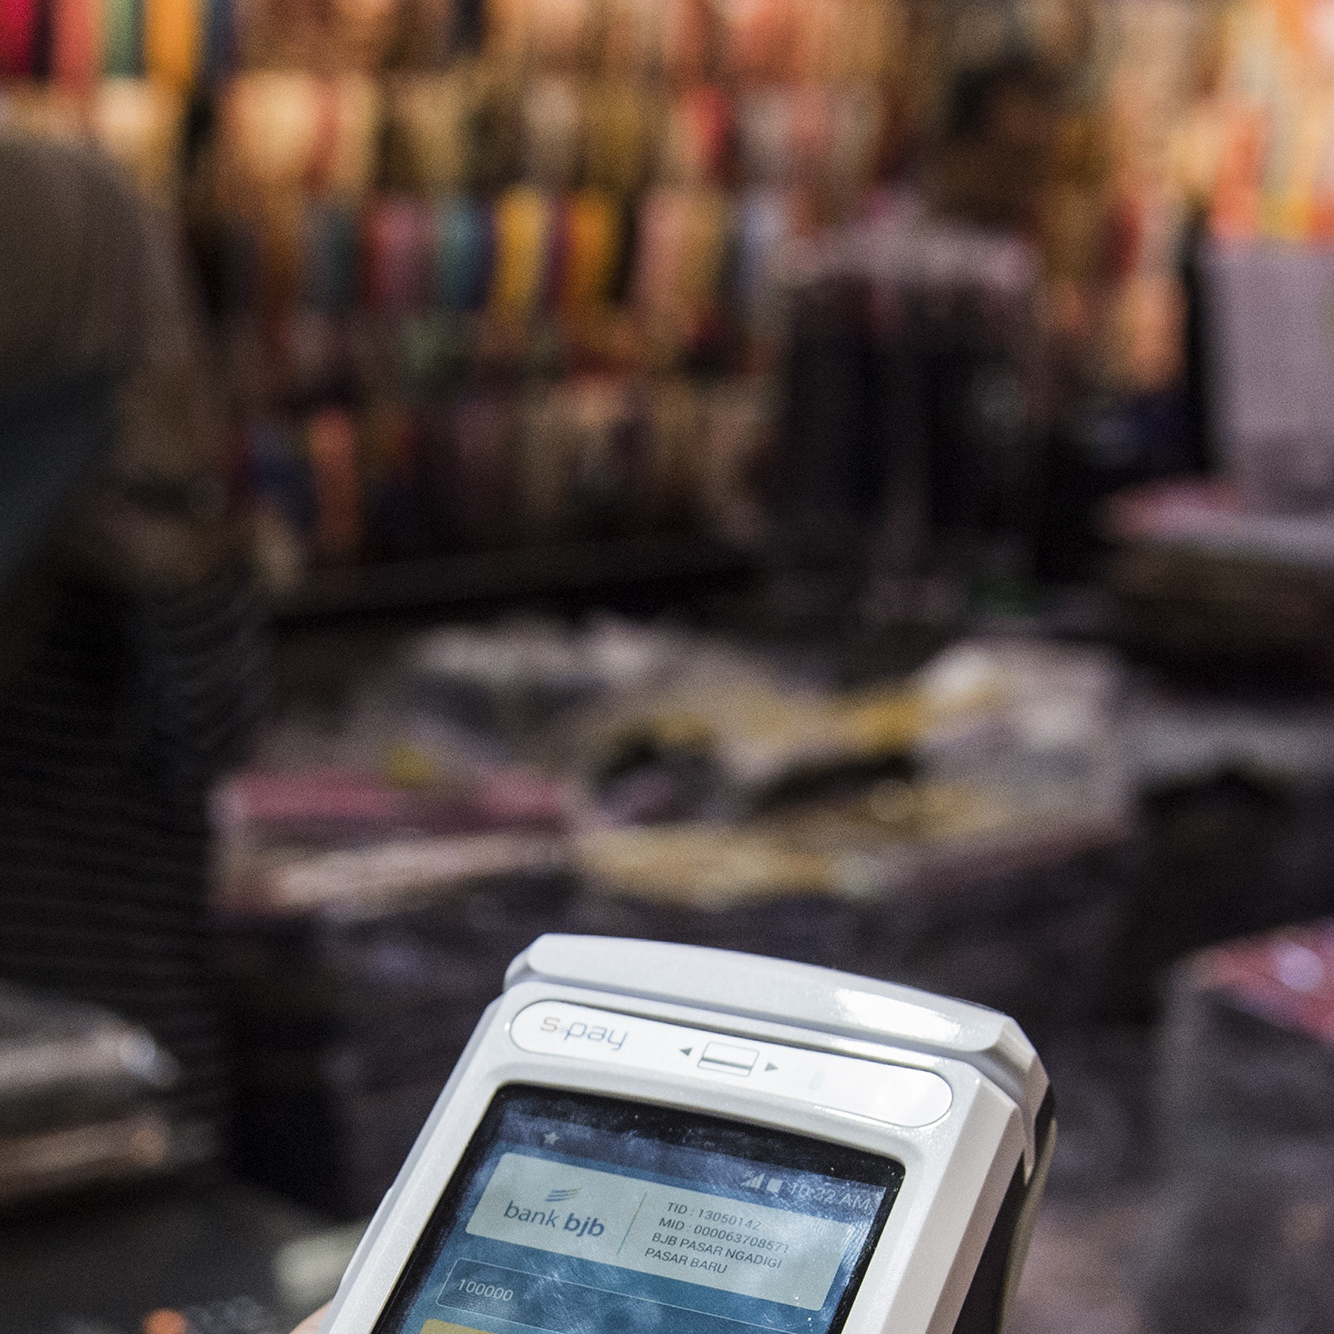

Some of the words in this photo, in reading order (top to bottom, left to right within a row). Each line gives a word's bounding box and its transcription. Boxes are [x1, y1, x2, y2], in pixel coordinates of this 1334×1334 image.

[840, 1193, 871, 1210] AM
[504, 1200, 559, 1228] bank
[564, 1213, 605, 1237] bjb
[668, 1202, 688, 1215] TID
[699, 1208, 762, 1231] 13050142
[659, 1217, 685, 1231] MID
[693, 1225, 789, 1254] 000063708571
[644, 1247, 689, 1266] PASAR
[690, 1257, 728, 1274] BARU
[652, 1232, 677, 1246] BJB
[679, 1238, 723, 1257] PASAR
[725, 1248, 782, 1269] NGADIGI
[458, 1279, 514, 1301] 100000
